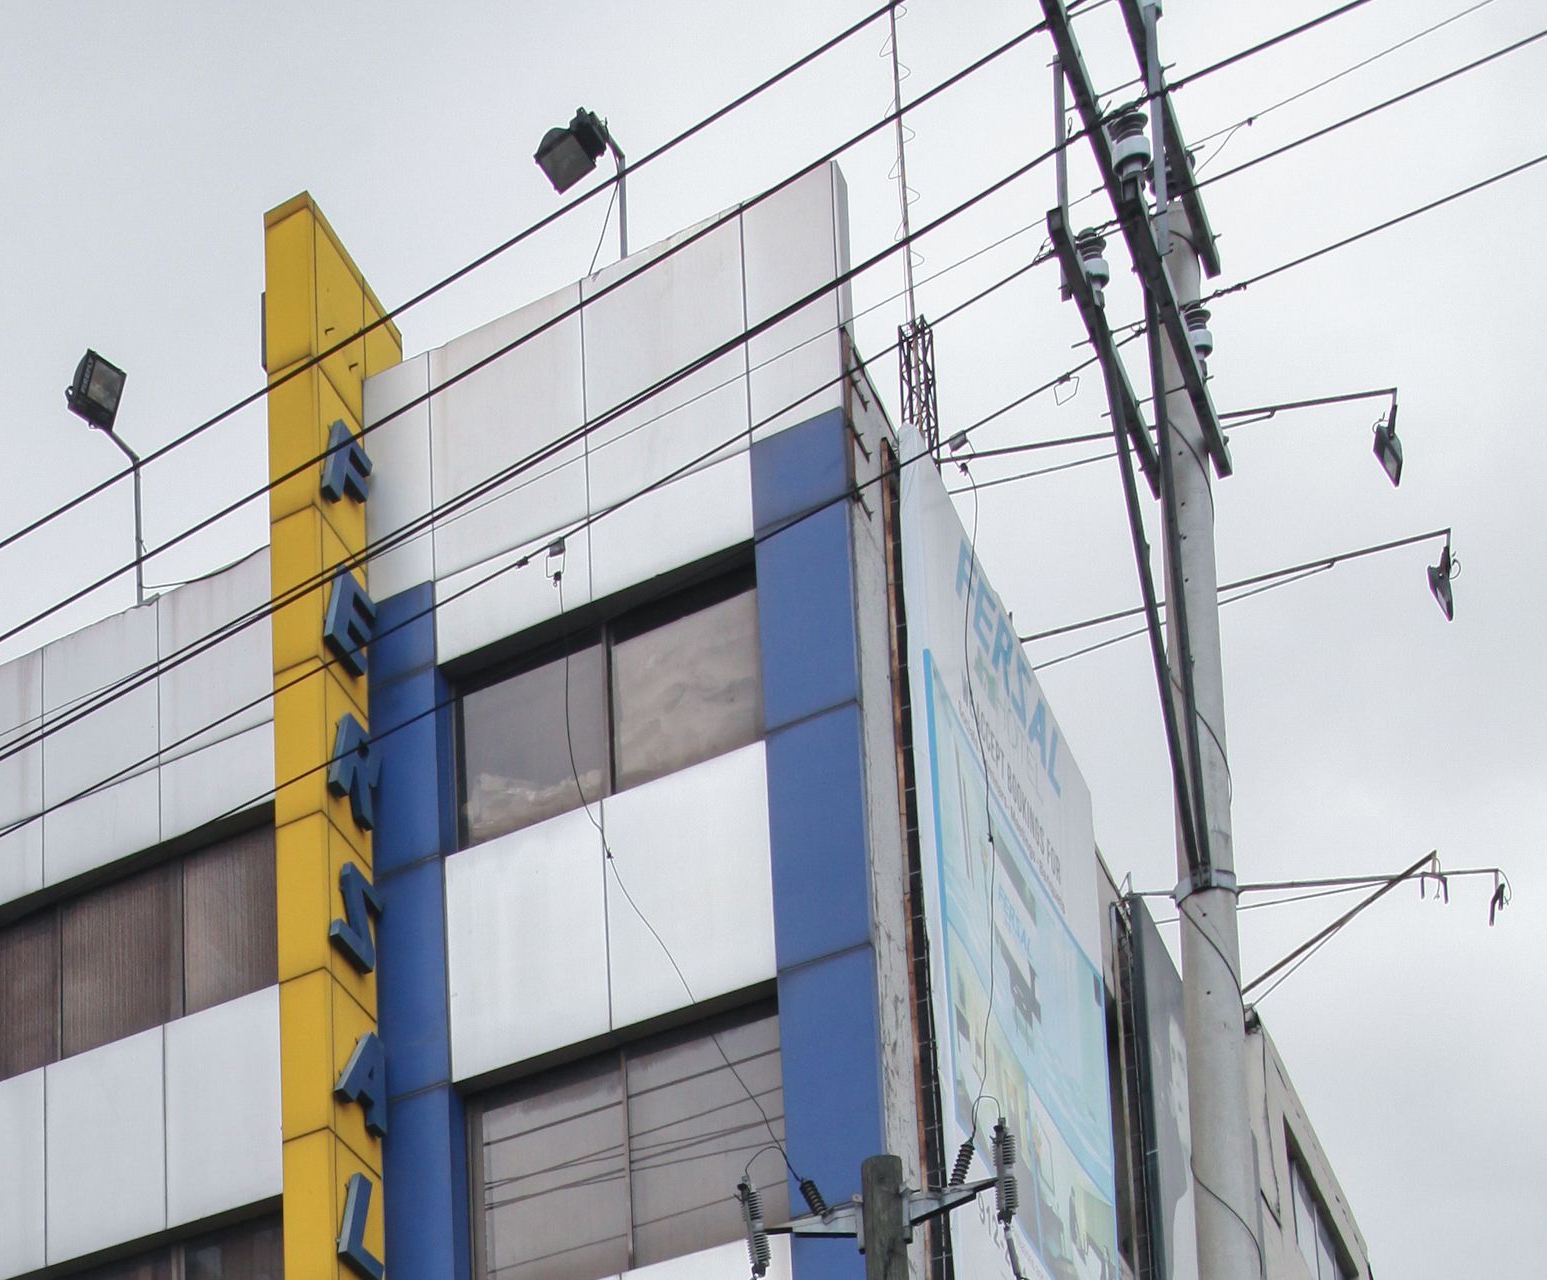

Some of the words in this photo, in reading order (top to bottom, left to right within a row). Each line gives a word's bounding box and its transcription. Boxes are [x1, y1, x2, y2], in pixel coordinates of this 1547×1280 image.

[954, 536, 1061, 800] FERSAL
[977, 703, 1005, 778] ACCEPT
[1007, 762, 1045, 857] BOOKINGS
[1046, 835, 1061, 886] FOR
